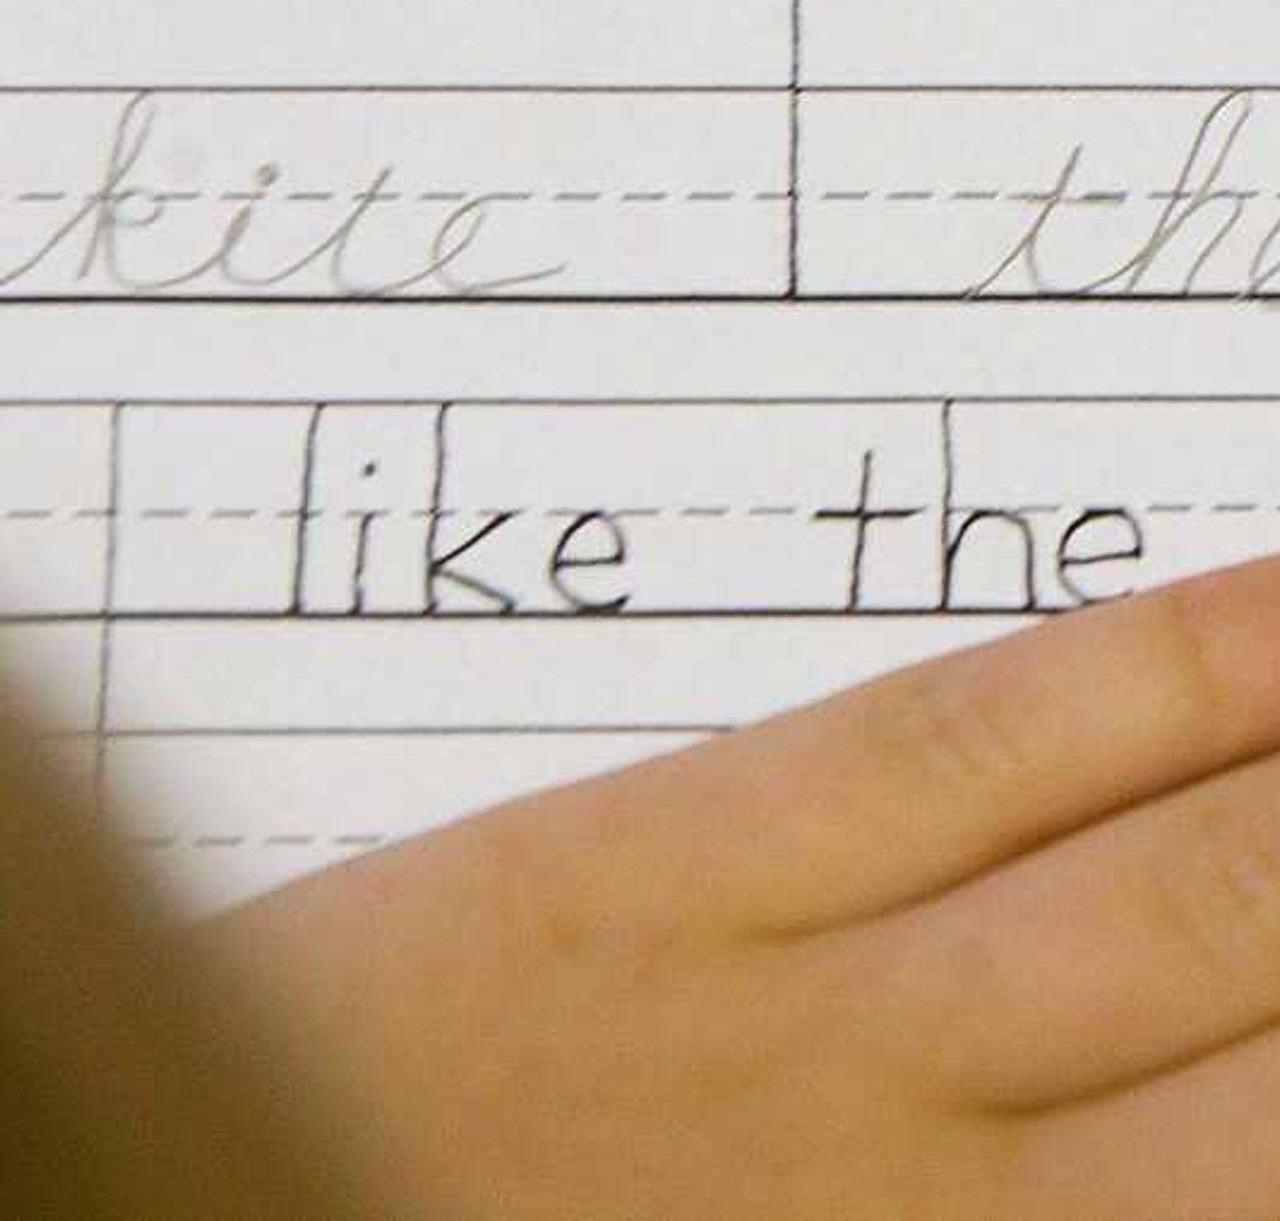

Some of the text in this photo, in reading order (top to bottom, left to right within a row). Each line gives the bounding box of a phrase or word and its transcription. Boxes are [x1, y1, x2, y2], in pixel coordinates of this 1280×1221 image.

[0, 89, 566, 297] kite
[288, 402, 631, 614] like
[814, 397, 1143, 612] the
